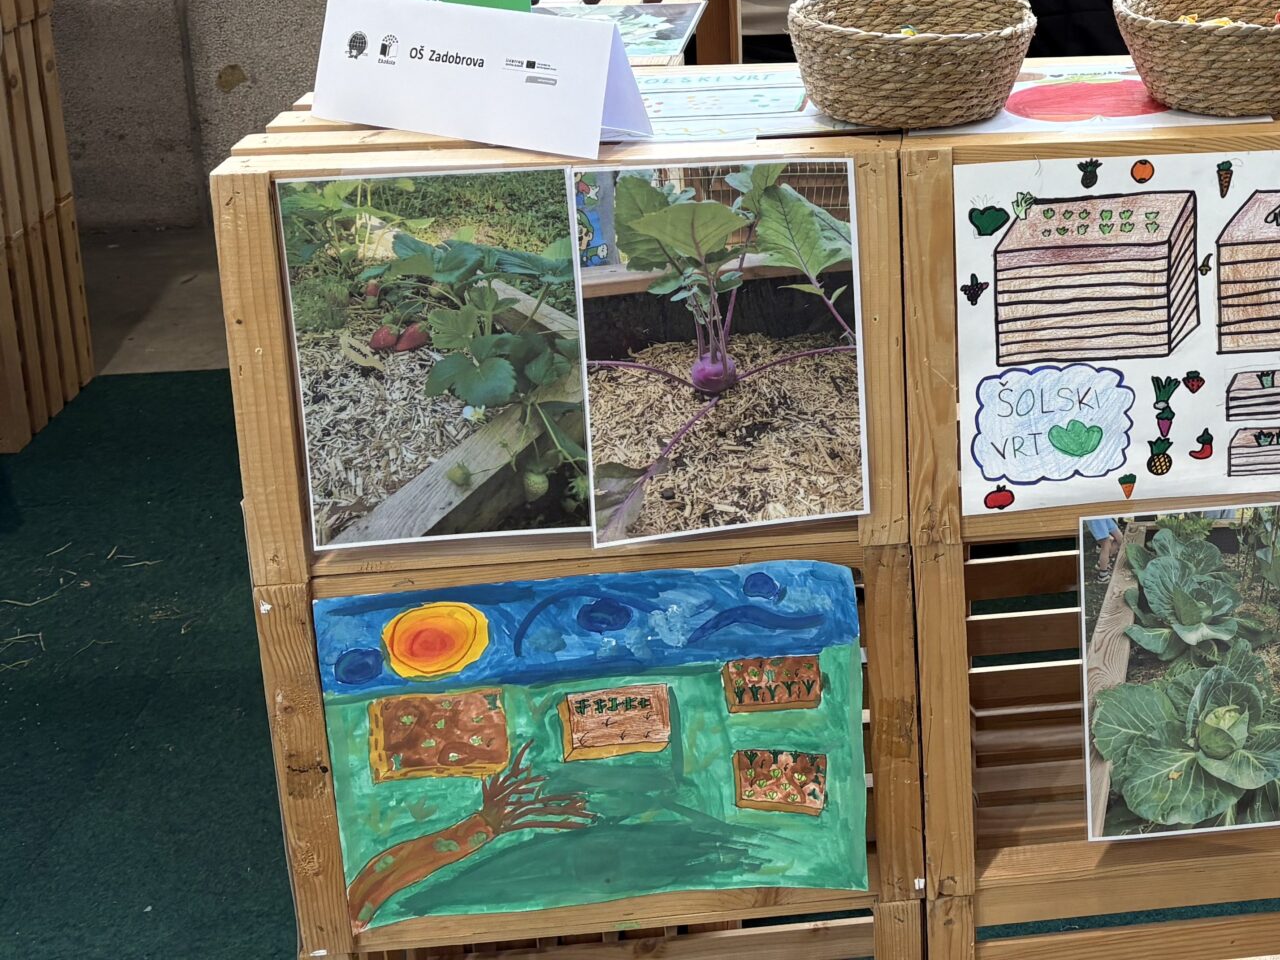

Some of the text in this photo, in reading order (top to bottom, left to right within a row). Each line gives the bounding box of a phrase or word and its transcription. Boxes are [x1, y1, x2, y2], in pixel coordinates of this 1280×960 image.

[409, 45, 424, 60] OŠ
[428, 49, 485, 68] Zadobrova
[996, 381, 1103, 418] ŠOLSKI
[990, 431, 1043, 459] VRT
